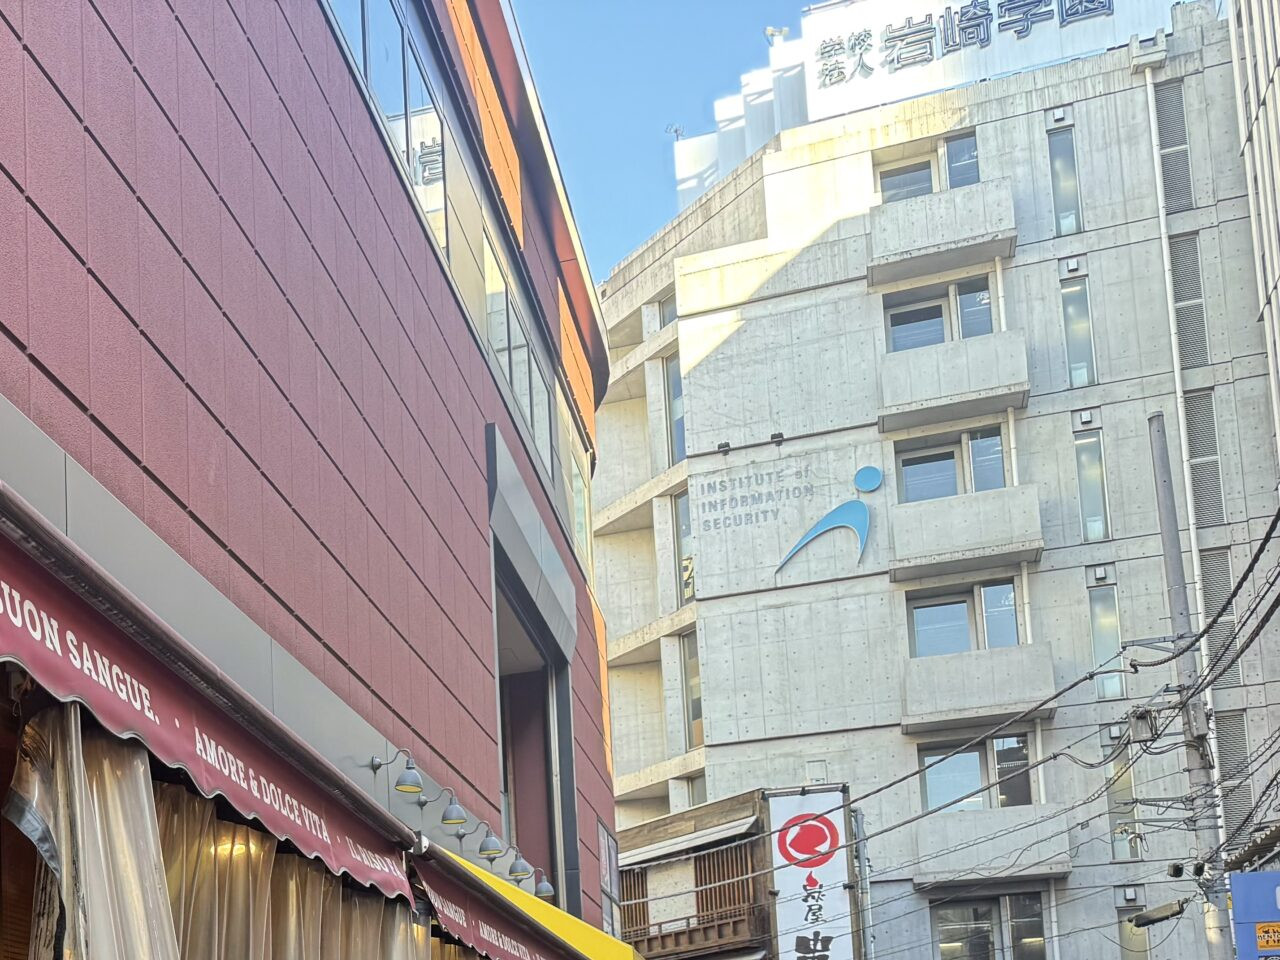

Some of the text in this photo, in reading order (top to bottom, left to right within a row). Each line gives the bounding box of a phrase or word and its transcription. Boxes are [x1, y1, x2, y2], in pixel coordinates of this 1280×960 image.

[818, 52, 873, 87] 法人
[700, 464, 810, 496] INSTITUTE of
[701, 484, 814, 514] INFORMATION
[703, 508, 780, 532] SECURITY
[66, 630, 160, 725] SANGUE.
[194, 726, 248, 790] AMORE
[248, 767, 261, 799] &
[260, 775, 302, 826] DOLCE
[300, 803, 331, 845] VITA
[345, 836, 362, 862] IL
[357, 844, 389, 873] RISO
